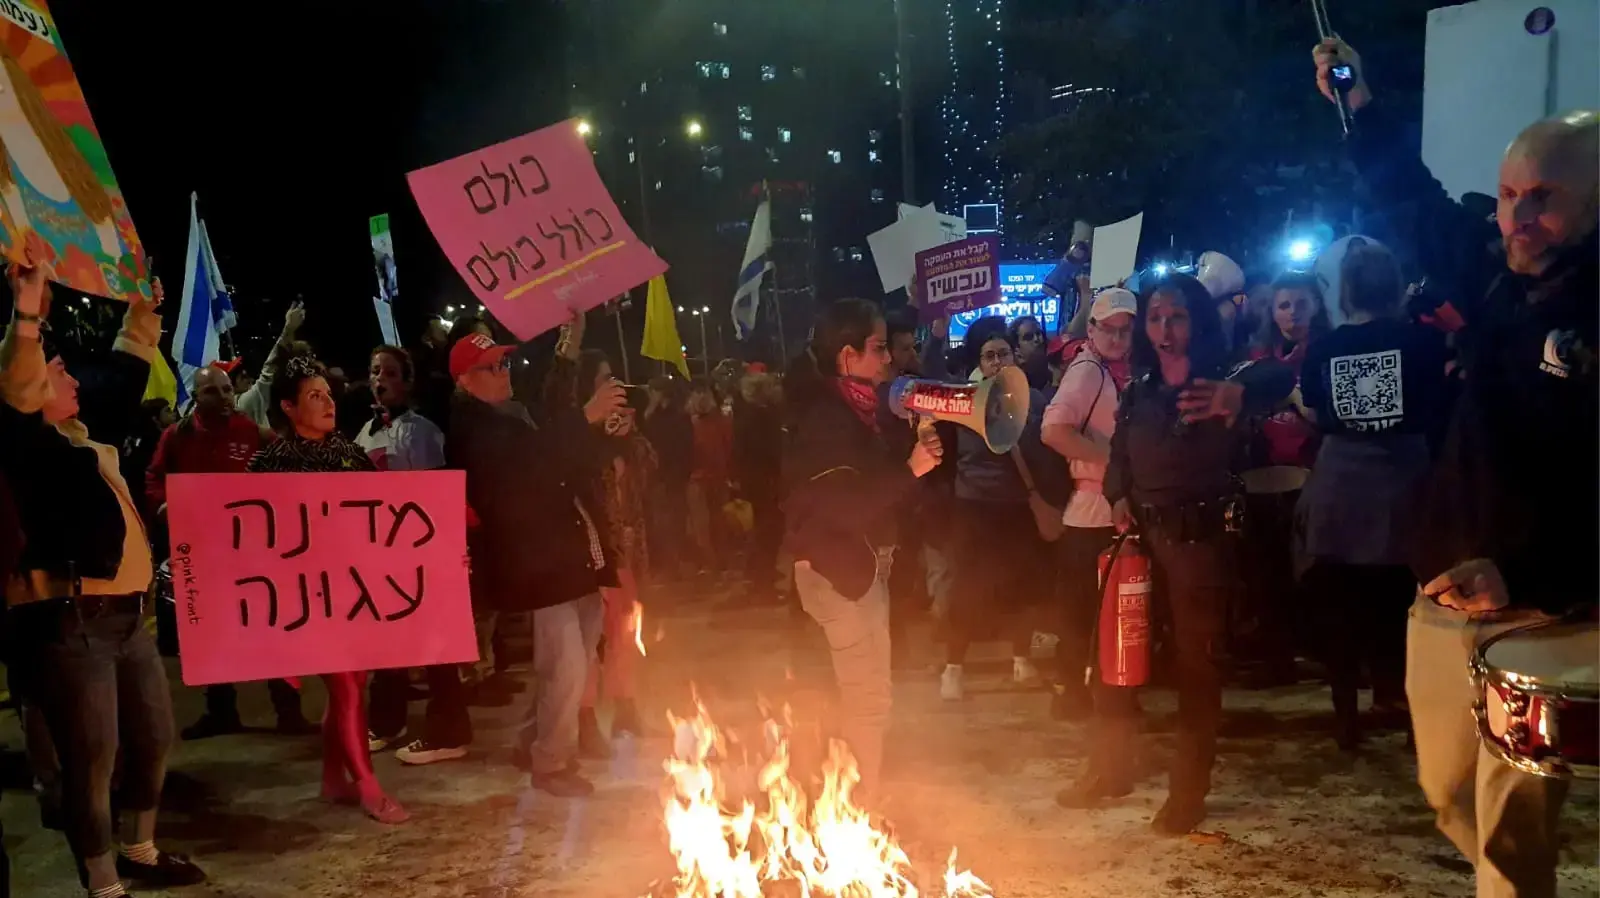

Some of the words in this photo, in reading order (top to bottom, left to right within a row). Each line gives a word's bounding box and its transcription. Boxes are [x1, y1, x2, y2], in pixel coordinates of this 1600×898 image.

[953, 248, 967, 258] את
[968, 241, 989, 255] לקבל
[924, 252, 952, 267] העסקה
[930, 271, 987, 297] עכשיו
[914, 394, 947, 411] אשם
[224, 499, 435, 559] מדינה
[175, 543, 204, 625] @pink.front
